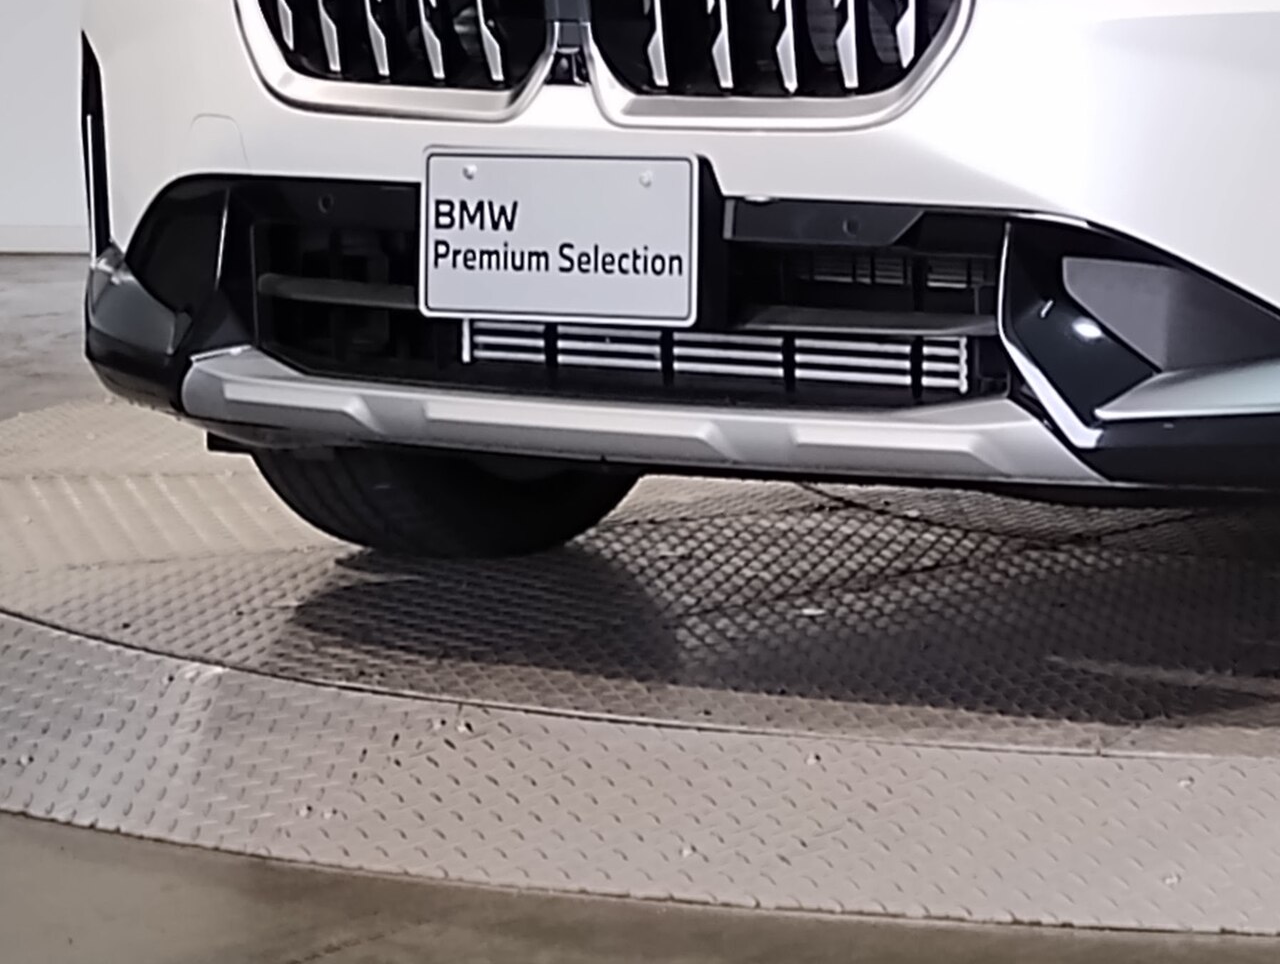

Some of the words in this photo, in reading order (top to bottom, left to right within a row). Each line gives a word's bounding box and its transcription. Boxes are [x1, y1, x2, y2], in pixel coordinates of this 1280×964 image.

[434, 199, 518, 231] BMW
[434, 240, 549, 272] Premium
[558, 242, 683, 276] Selection
